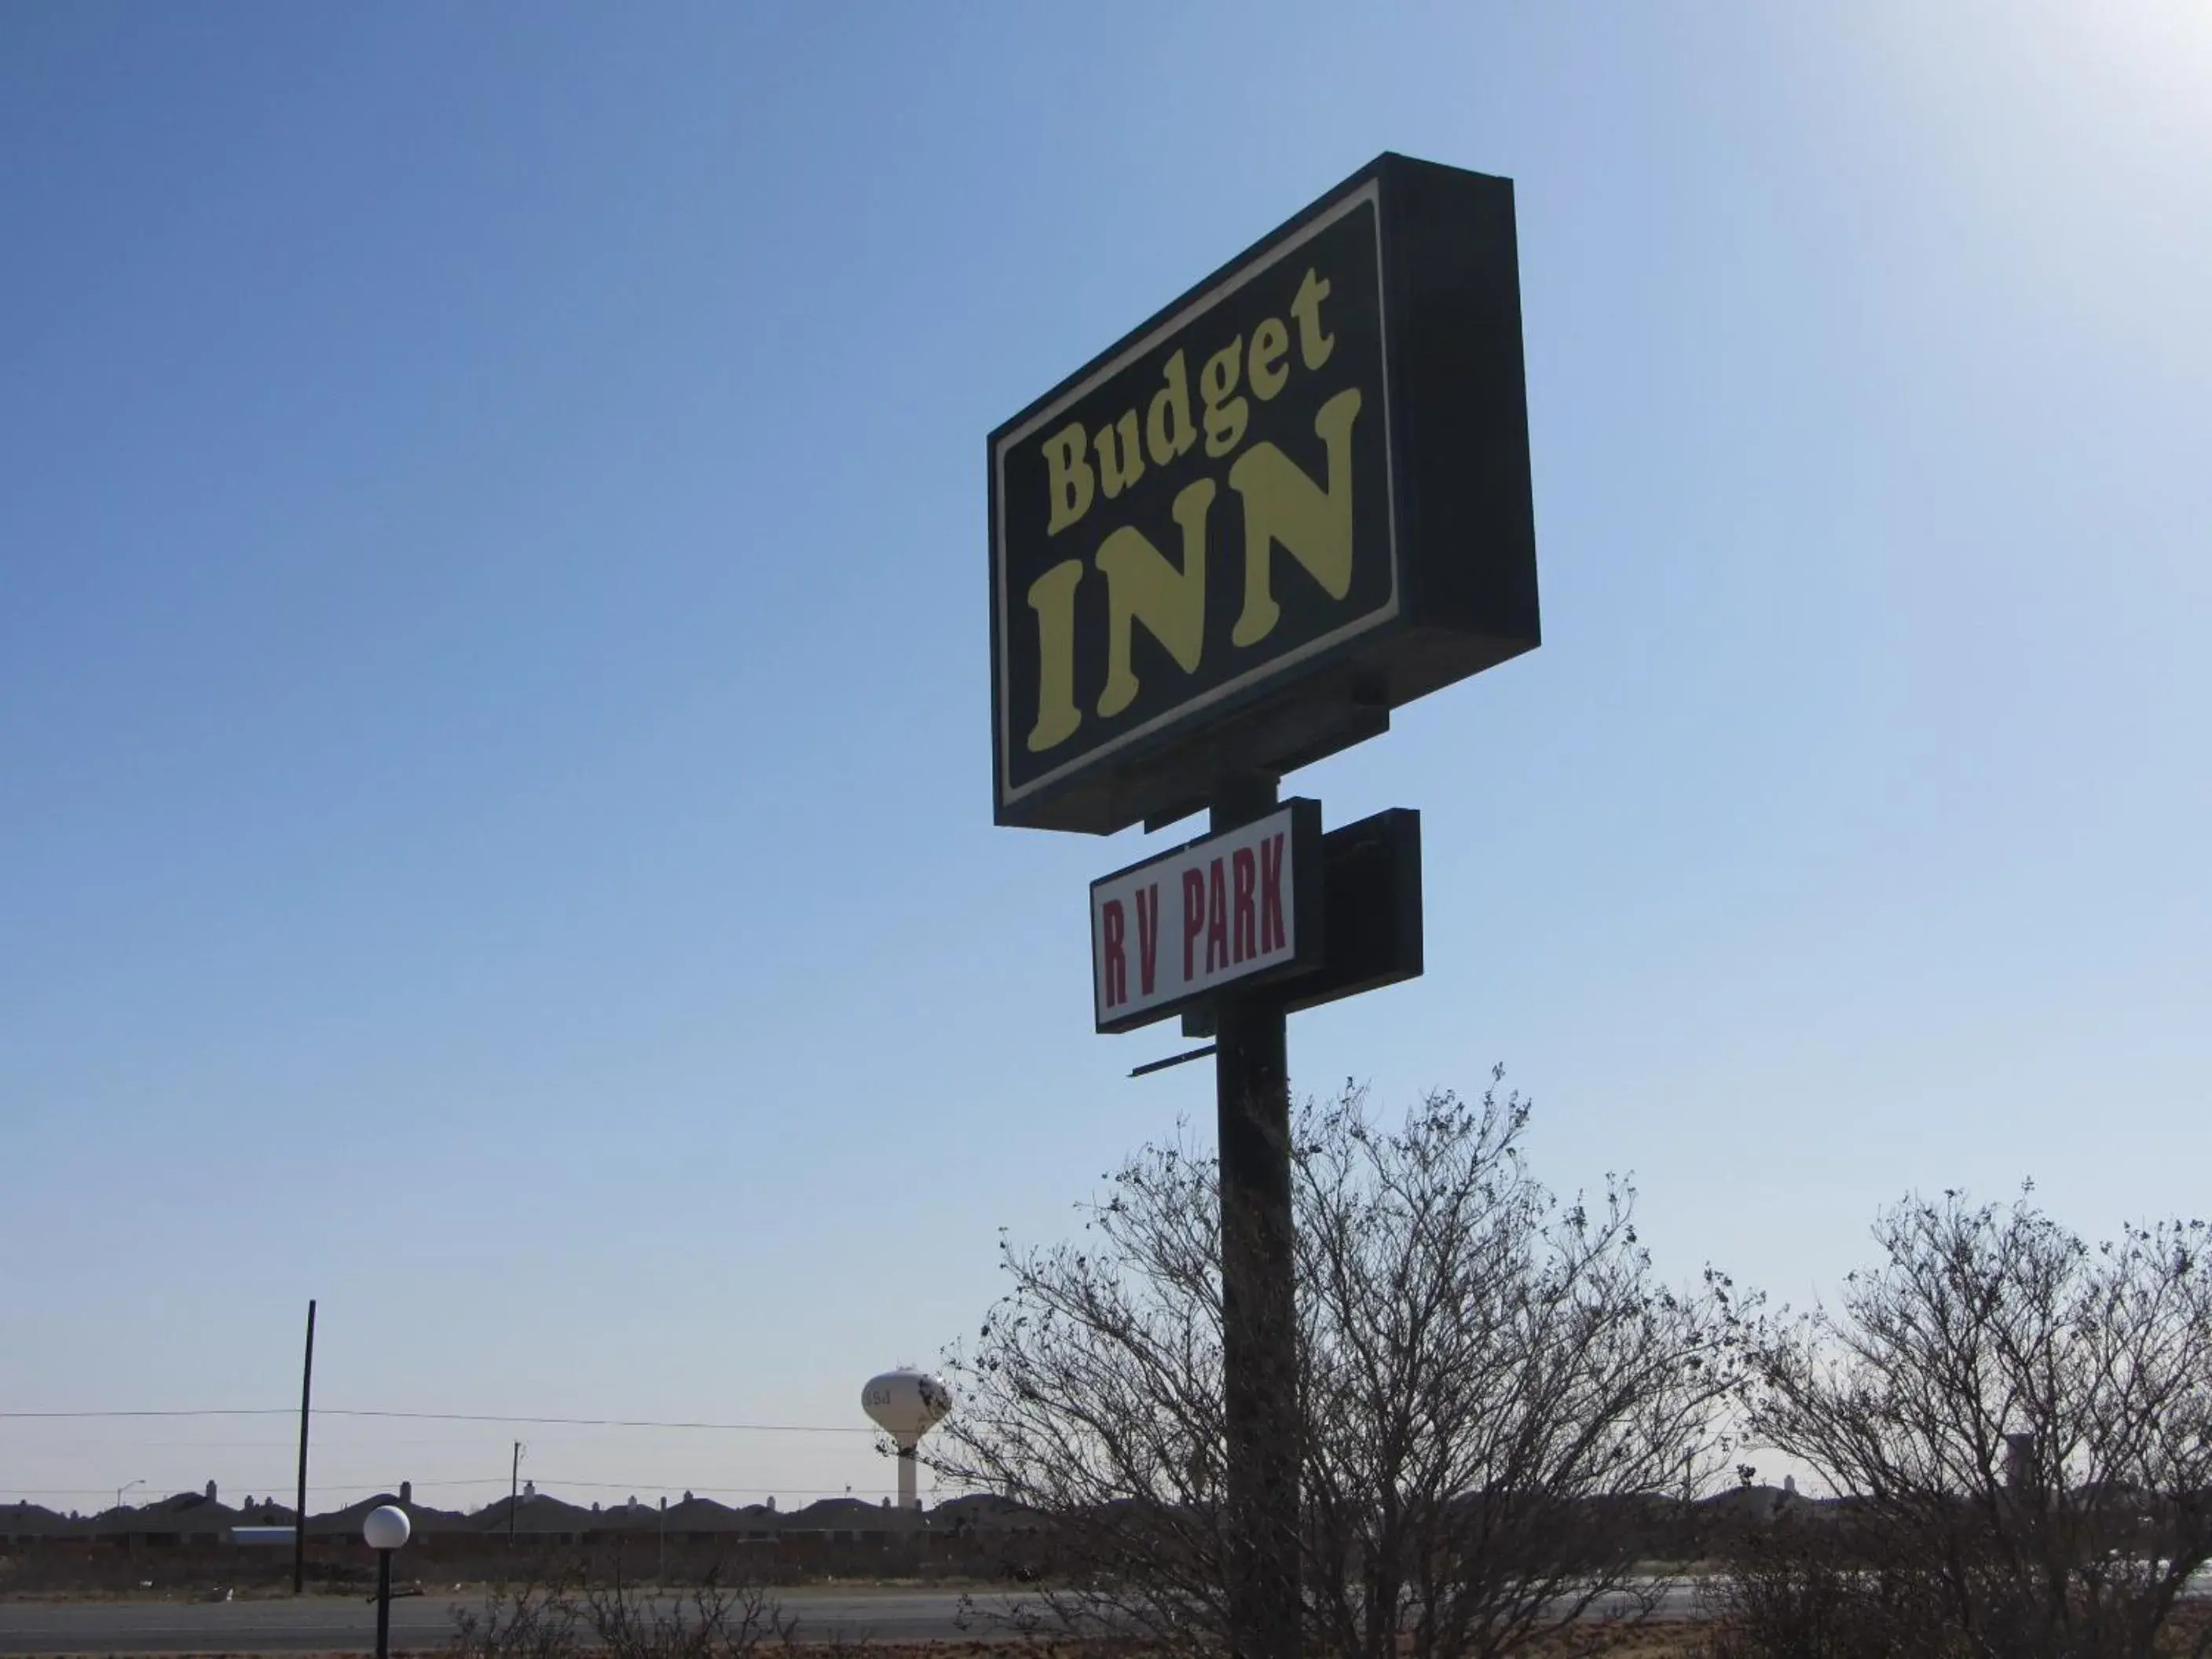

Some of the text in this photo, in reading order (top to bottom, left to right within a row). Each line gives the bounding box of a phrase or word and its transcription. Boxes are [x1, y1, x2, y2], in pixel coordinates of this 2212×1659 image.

[1042, 268, 1335, 537] Budget
[1027, 386, 1362, 753] INN
[1102, 832, 1287, 1009] RV PARK
